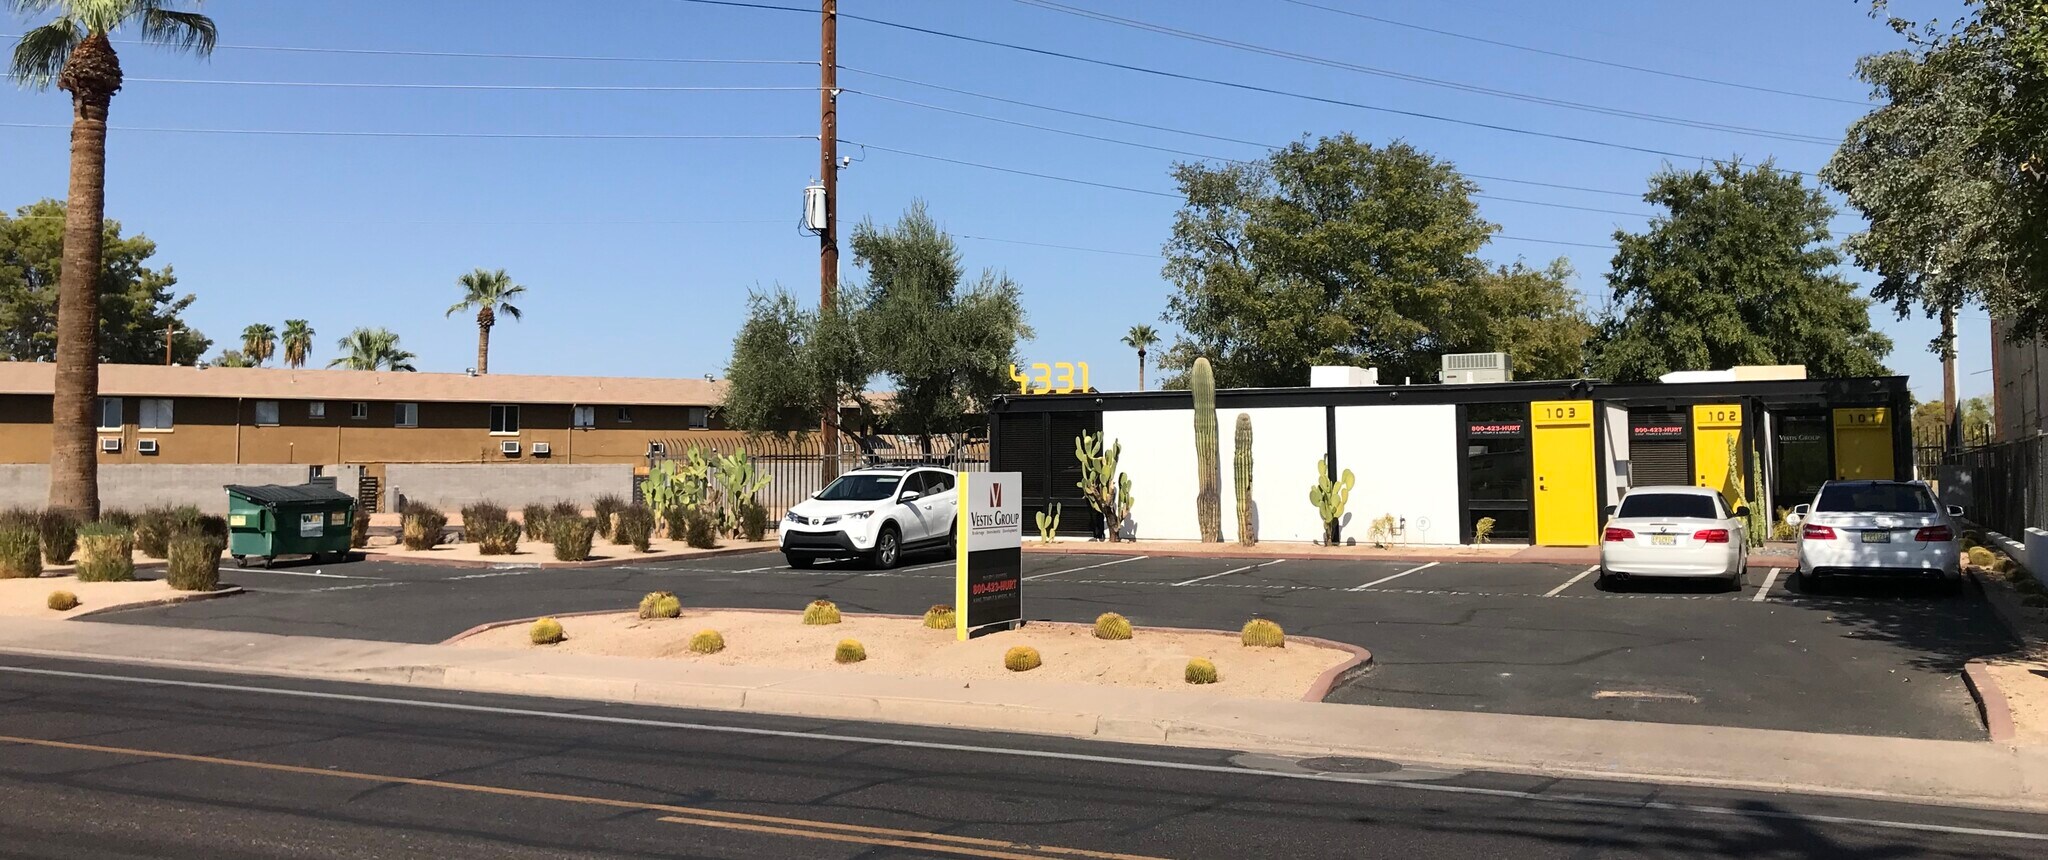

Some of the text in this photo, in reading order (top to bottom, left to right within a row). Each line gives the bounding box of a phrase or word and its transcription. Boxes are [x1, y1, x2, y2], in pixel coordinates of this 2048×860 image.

[1009, 361, 1089, 395] 4331
[1547, 407, 1576, 418] 103
[1709, 411, 1736, 421] 102
[1848, 413, 1876, 424] 101
[1471, 424, 1521, 432] 800-423-HURT
[303, 514, 321, 522] WM
[971, 510, 1020, 527] VESTIS GROUP
[972, 578, 1017, 595] 800-423-HURT
